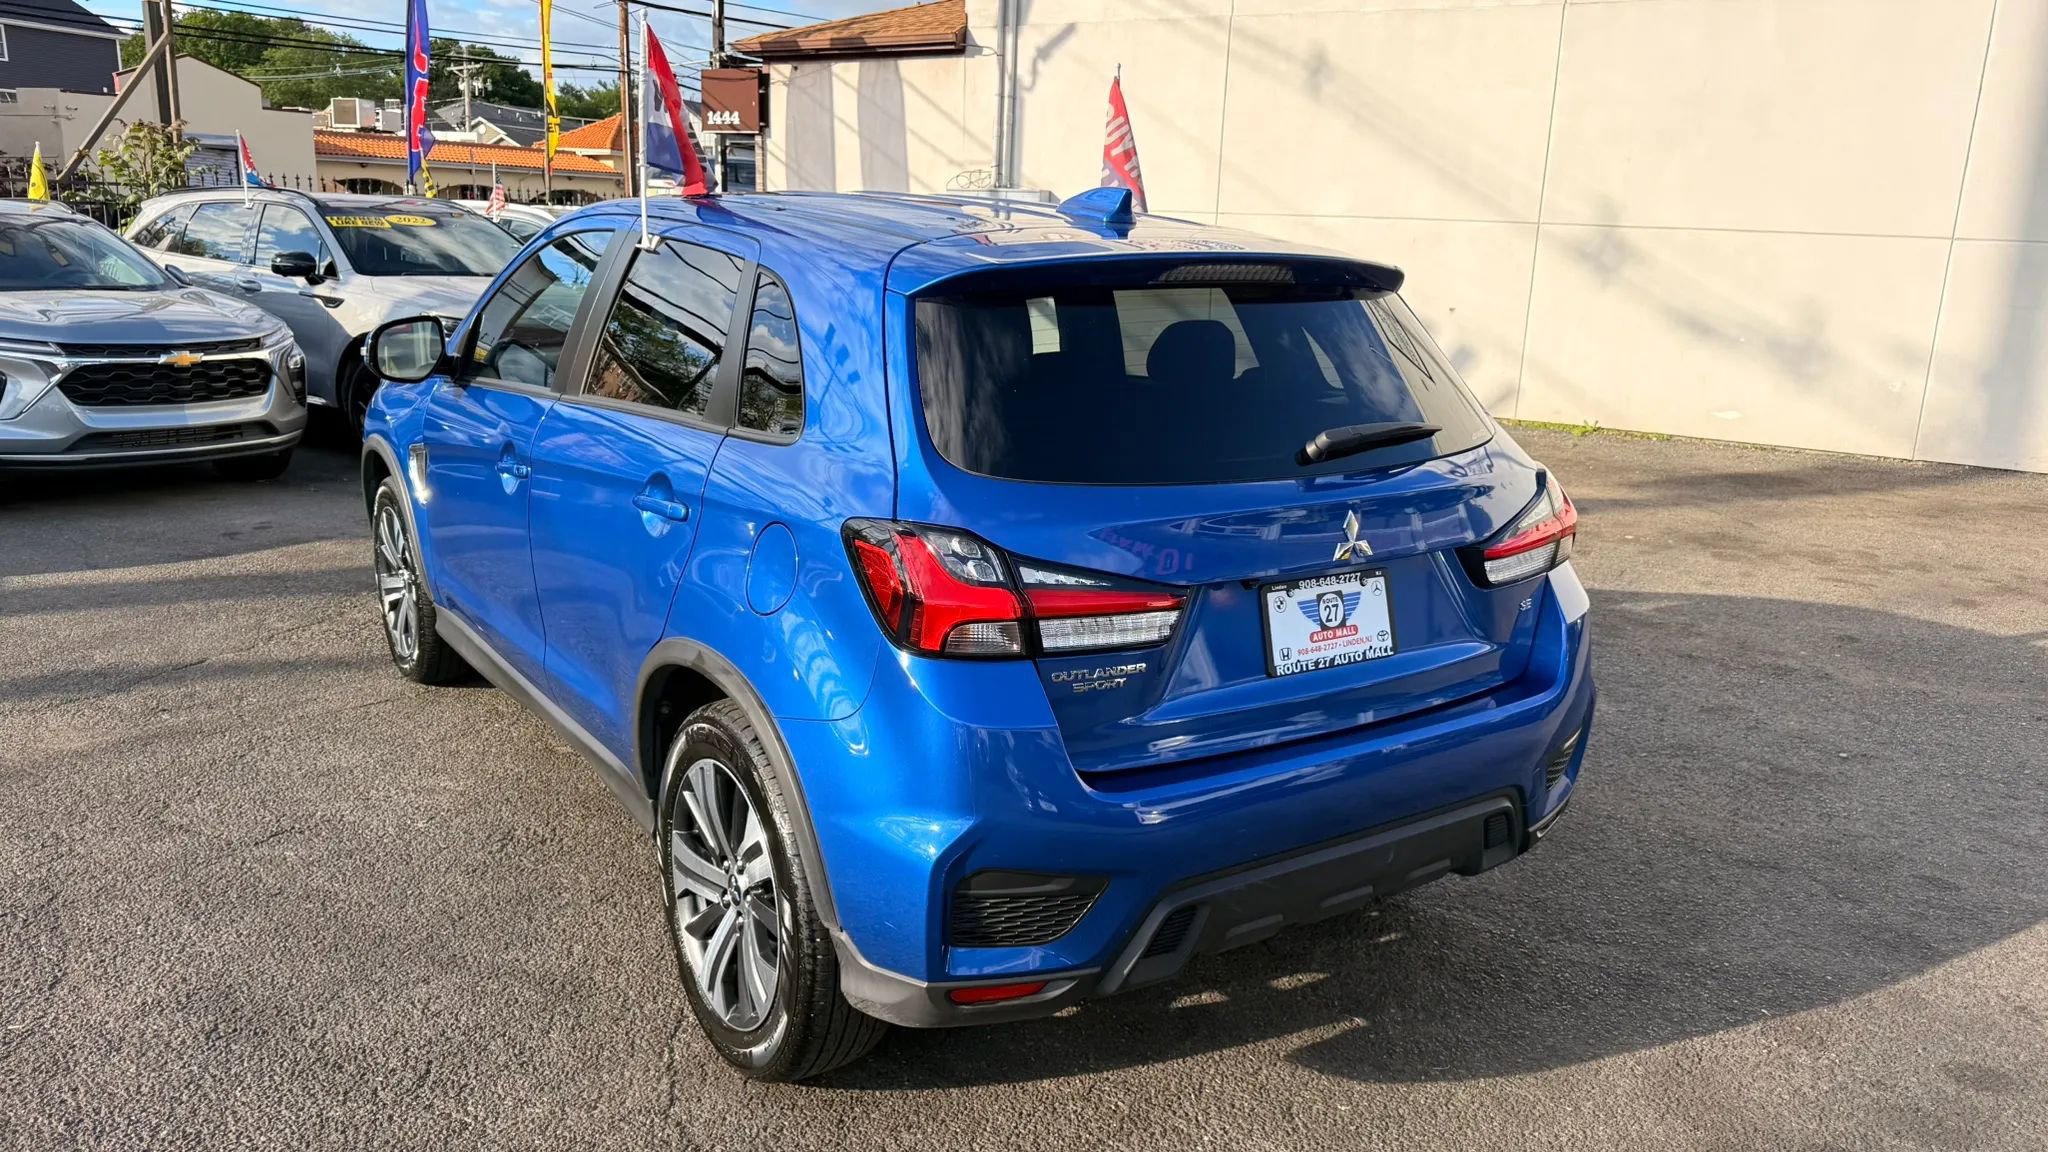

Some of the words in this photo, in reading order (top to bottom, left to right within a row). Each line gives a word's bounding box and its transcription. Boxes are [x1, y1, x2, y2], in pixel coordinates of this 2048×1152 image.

[707, 110, 741, 125] 1444
[1298, 572, 1361, 590] 908-648-2727
[1322, 597, 1339, 605] ROUTE
[1519, 598, 1532, 611] SE
[1323, 603, 1339, 623] 27
[1312, 631, 1334, 641] AUTO
[1335, 626, 1357, 637] MALL
[1297, 642, 1338, 656] 908-648-2727
[1276, 660, 1316, 676] ROUTE
[1318, 656, 1331, 669] 27
[1334, 651, 1363, 666] AUTO
[1365, 645, 1395, 660] MALL
[1051, 662, 1147, 683] OUTLANDER
[1072, 677, 1127, 693] SPORT
